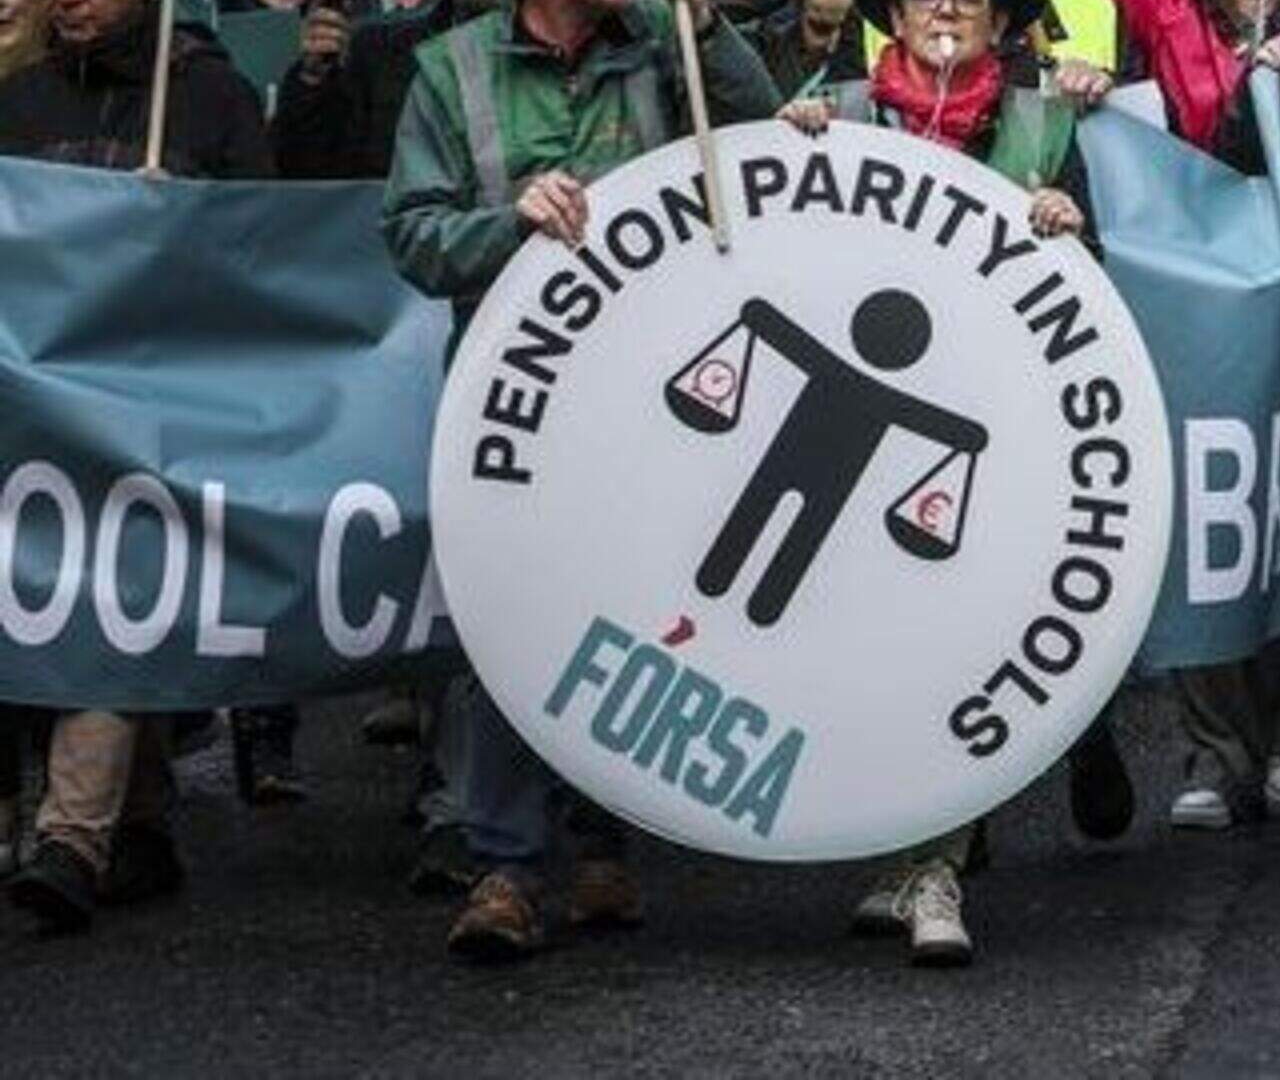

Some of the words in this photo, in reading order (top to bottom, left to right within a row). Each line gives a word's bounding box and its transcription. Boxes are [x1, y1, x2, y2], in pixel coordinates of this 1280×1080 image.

[473, 173, 713, 483] PENSION
[741, 154, 1040, 277] PARITY
[1014, 271, 1099, 366] IN
[948, 376, 1132, 760] SCHOOLS
[542, 614, 806, 839] FÓRSA
